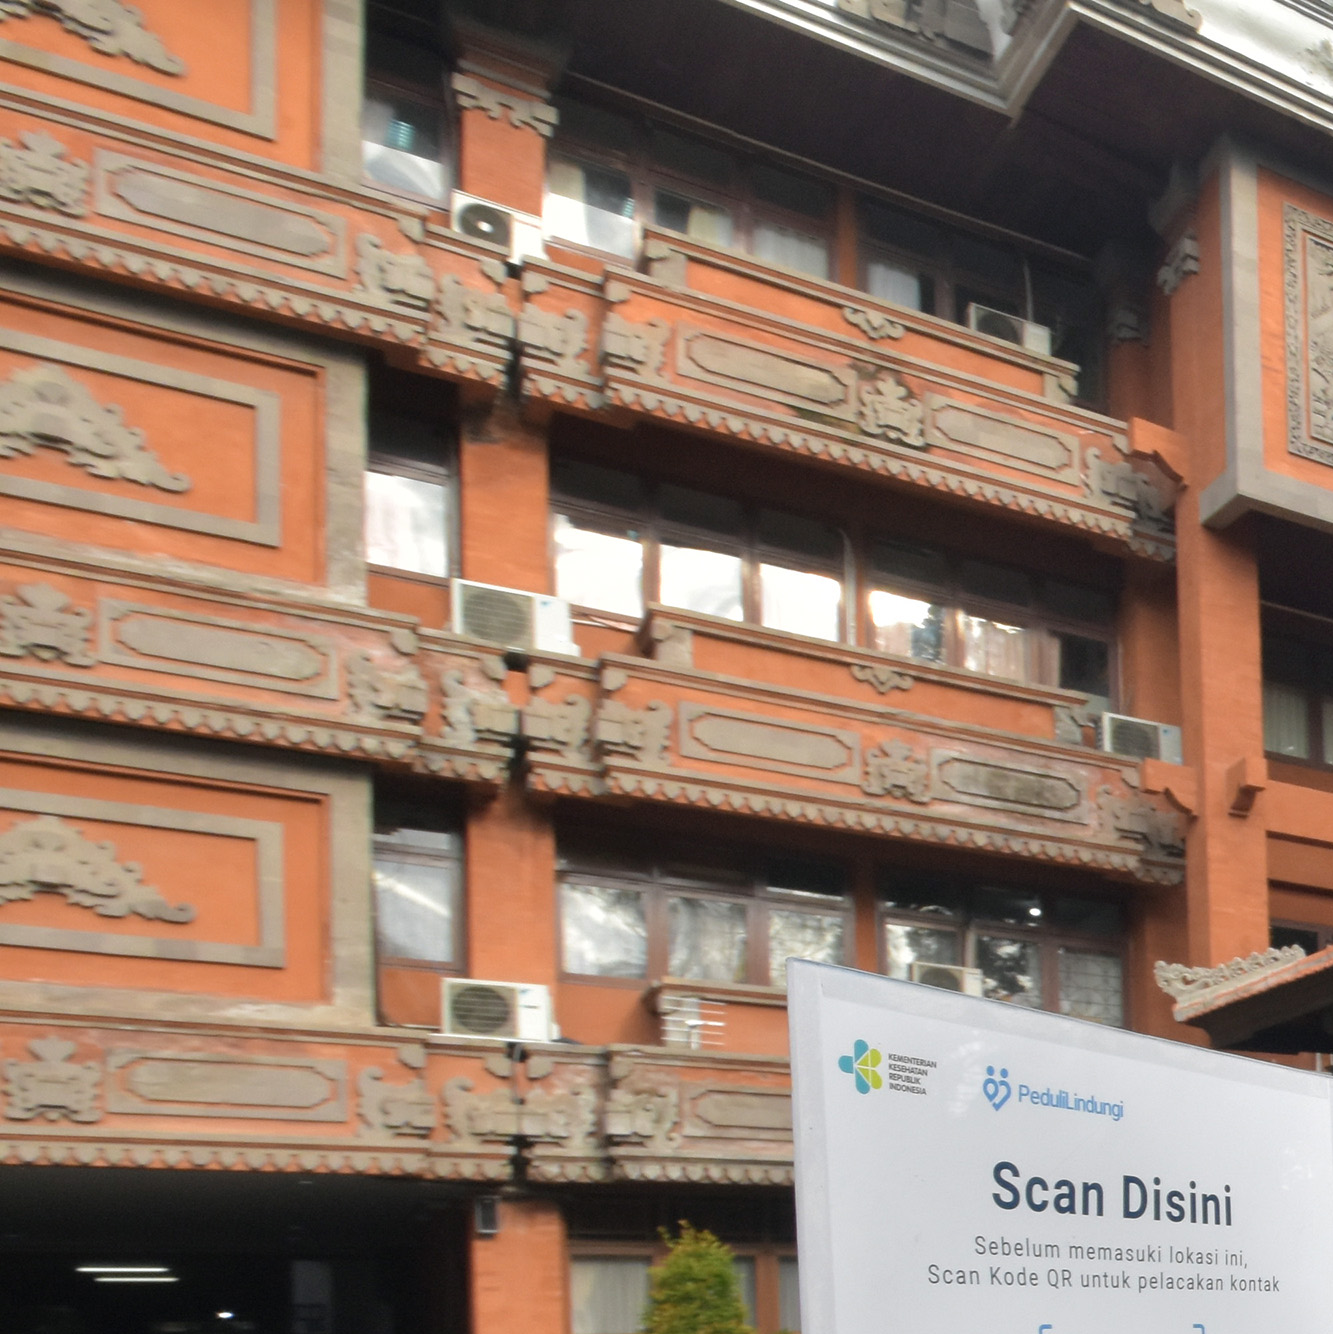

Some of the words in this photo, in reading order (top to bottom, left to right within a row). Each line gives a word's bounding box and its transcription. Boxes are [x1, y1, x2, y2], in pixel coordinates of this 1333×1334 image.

[888, 1053, 938, 1069] KEMENTERIAN
[888, 1062, 929, 1076] KESEHATAN
[888, 1071, 921, 1085] REPUBLIK
[889, 1081, 928, 1096] INDONESIA
[1018, 1083, 1125, 1122] PeduliLindungi
[991, 1160, 1105, 1217] Scan
[1121, 1174, 1232, 1227] Disini
[974, 1234, 1061, 1259] Sebelum
[1068, 1243, 1162, 1263] memasuki
[1169, 1244, 1219, 1265] lokasi
[1225, 1248, 1248, 1270] ini,
[927, 1263, 981, 1285] Scan
[989, 1265, 1039, 1287] Kode
[1047, 1267, 1073, 1290] QR
[1080, 1269, 1131, 1289] untuk
[1137, 1271, 1224, 1294] pelacakan
[1230, 1273, 1280, 1292] kontak
